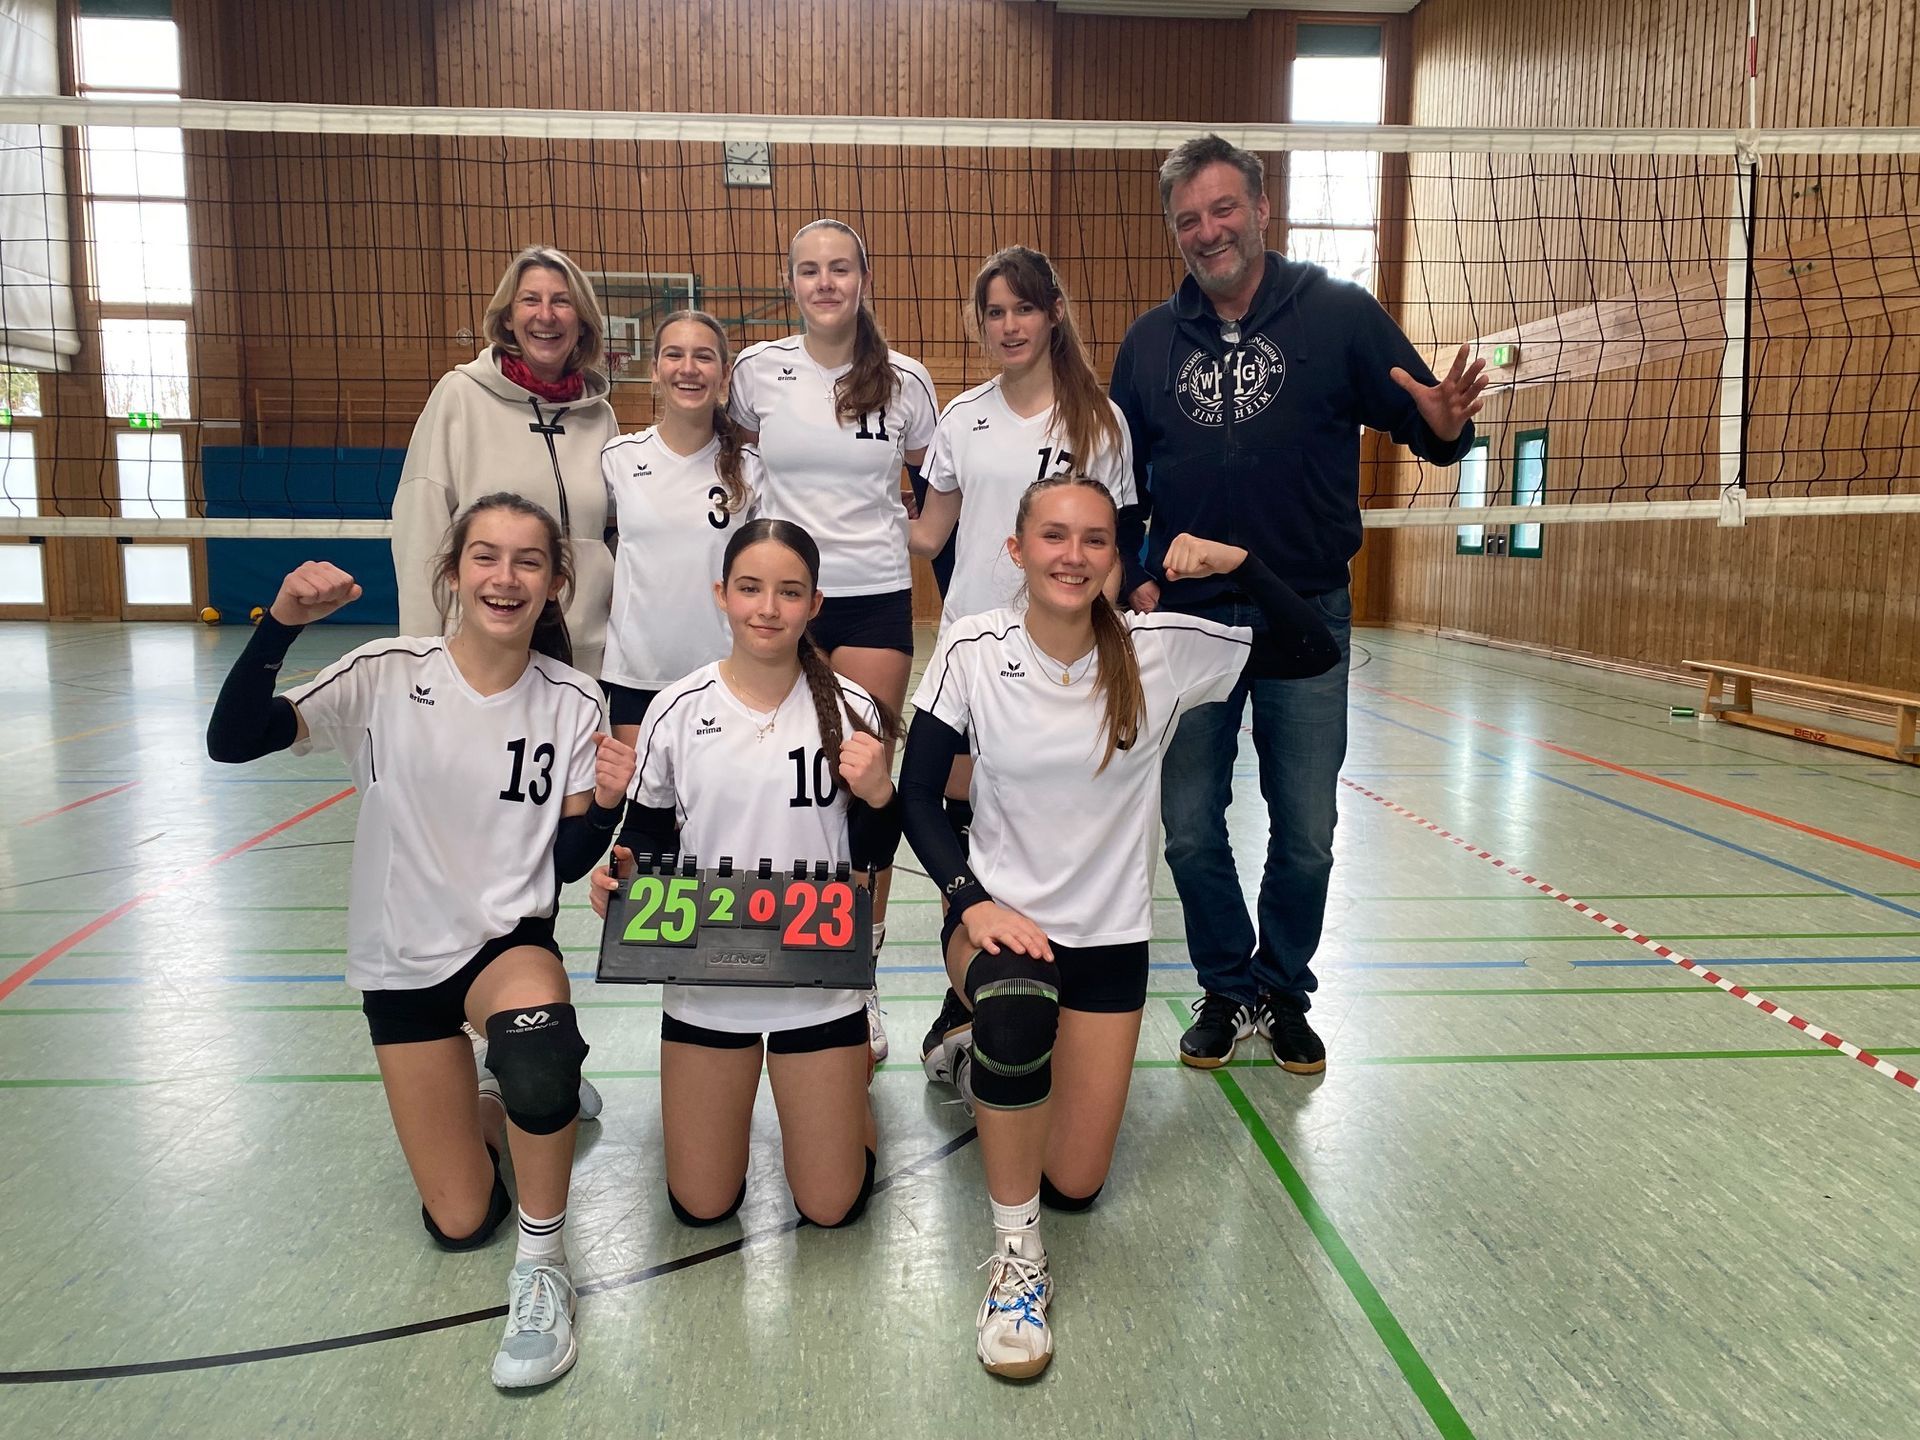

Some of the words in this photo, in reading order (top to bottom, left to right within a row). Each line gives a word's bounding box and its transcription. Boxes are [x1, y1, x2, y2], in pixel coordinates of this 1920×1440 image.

[1178, 382, 1188, 394] 18
[1270, 364, 1283, 374] 43
[708, 486, 730, 530] 3
[1000, 670, 1026, 678] erima
[409, 693, 435, 706] erima
[696, 726, 722, 736] erima
[1794, 728, 1826, 741] BENZ
[499, 737, 556, 806] 13
[788, 746, 840, 808] 10
[622, 876, 700, 943] 25
[707, 887, 735, 922] 2
[749, 889, 776, 923] 0
[782, 882, 855, 948] 23
